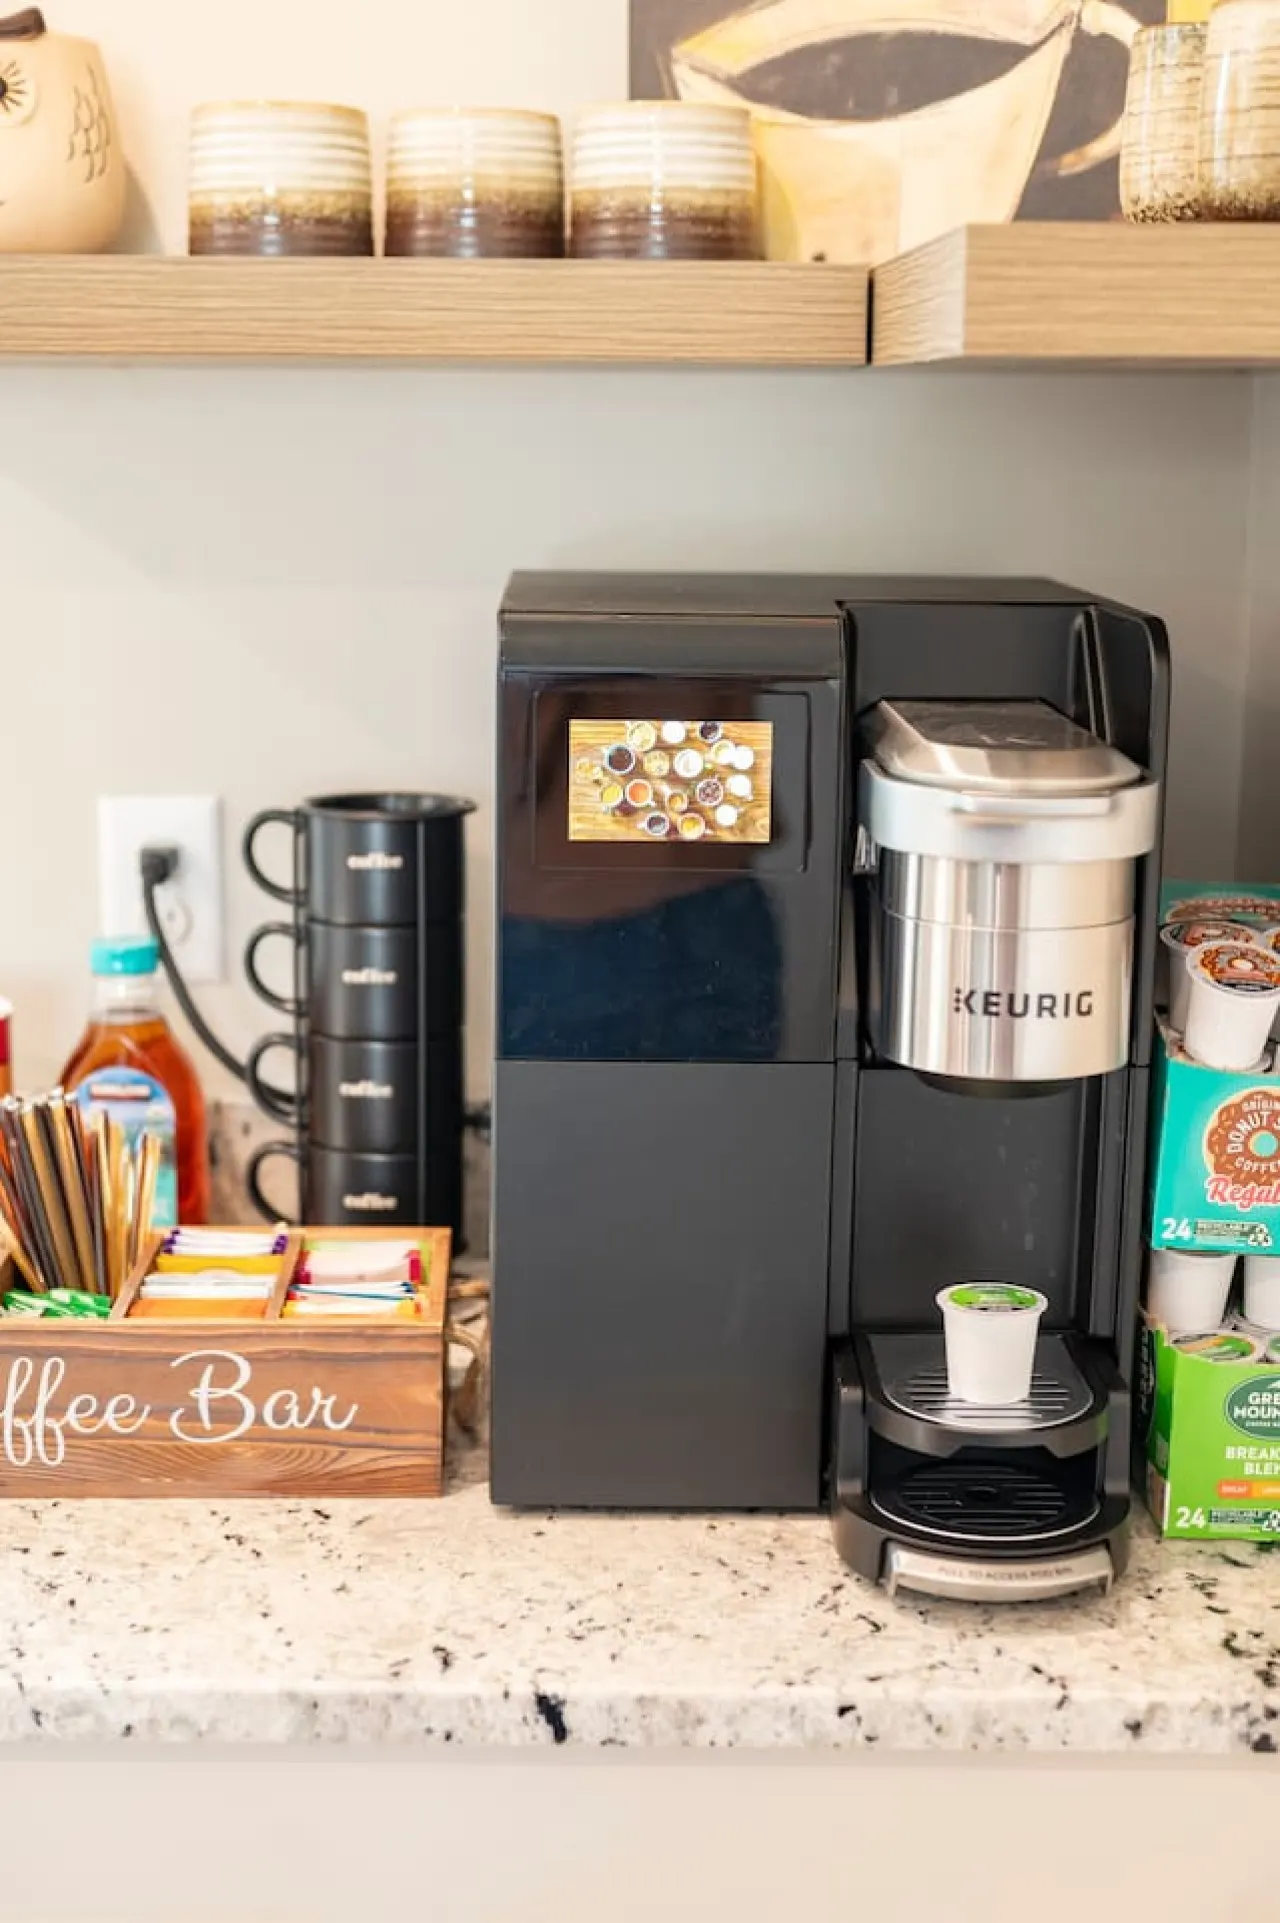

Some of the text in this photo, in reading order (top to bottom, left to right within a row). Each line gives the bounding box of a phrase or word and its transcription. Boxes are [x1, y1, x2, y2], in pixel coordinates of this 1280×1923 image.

[954, 987, 1093, 1018] KEURIG
[1227, 1111, 1272, 1153] DONUT
[1161, 1218, 1191, 1240] 24
[169, 1349, 360, 1444] Bar
[1176, 1507, 1206, 1528] 24
